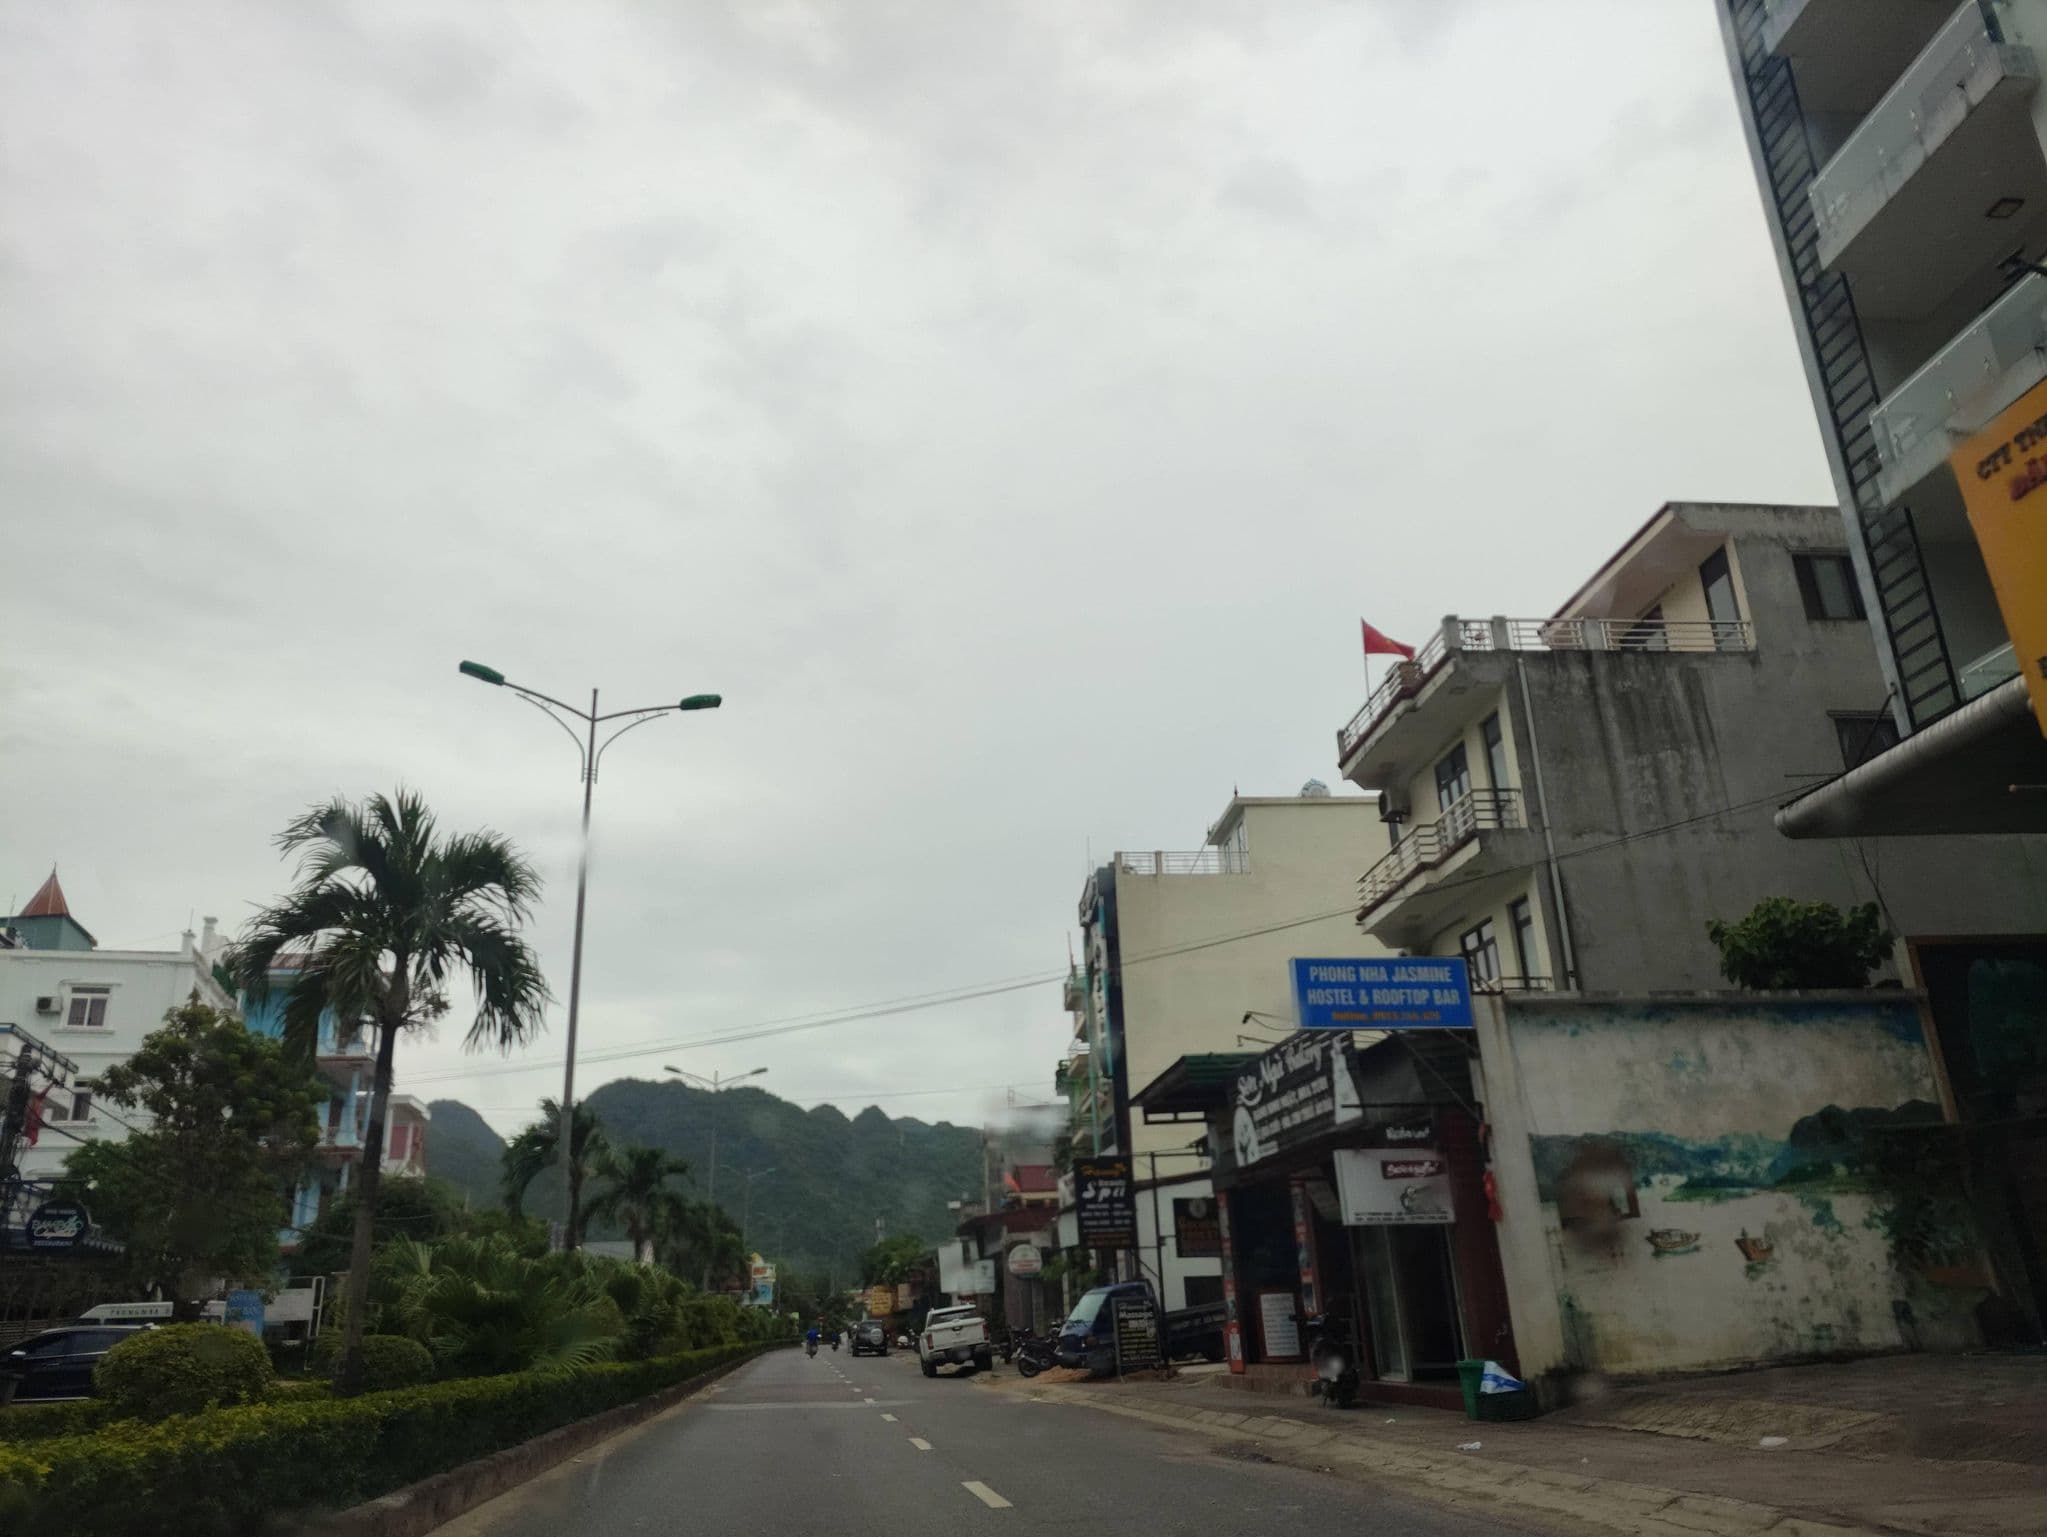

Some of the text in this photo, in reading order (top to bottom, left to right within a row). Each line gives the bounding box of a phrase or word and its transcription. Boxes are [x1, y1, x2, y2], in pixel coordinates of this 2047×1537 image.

[1310, 966, 1453, 982] PHONG NHA JASMINE
[1307, 989, 1461, 1005] HOSTEL & ROOFTOP BAR
[1082, 1181, 1126, 1202] Spa
